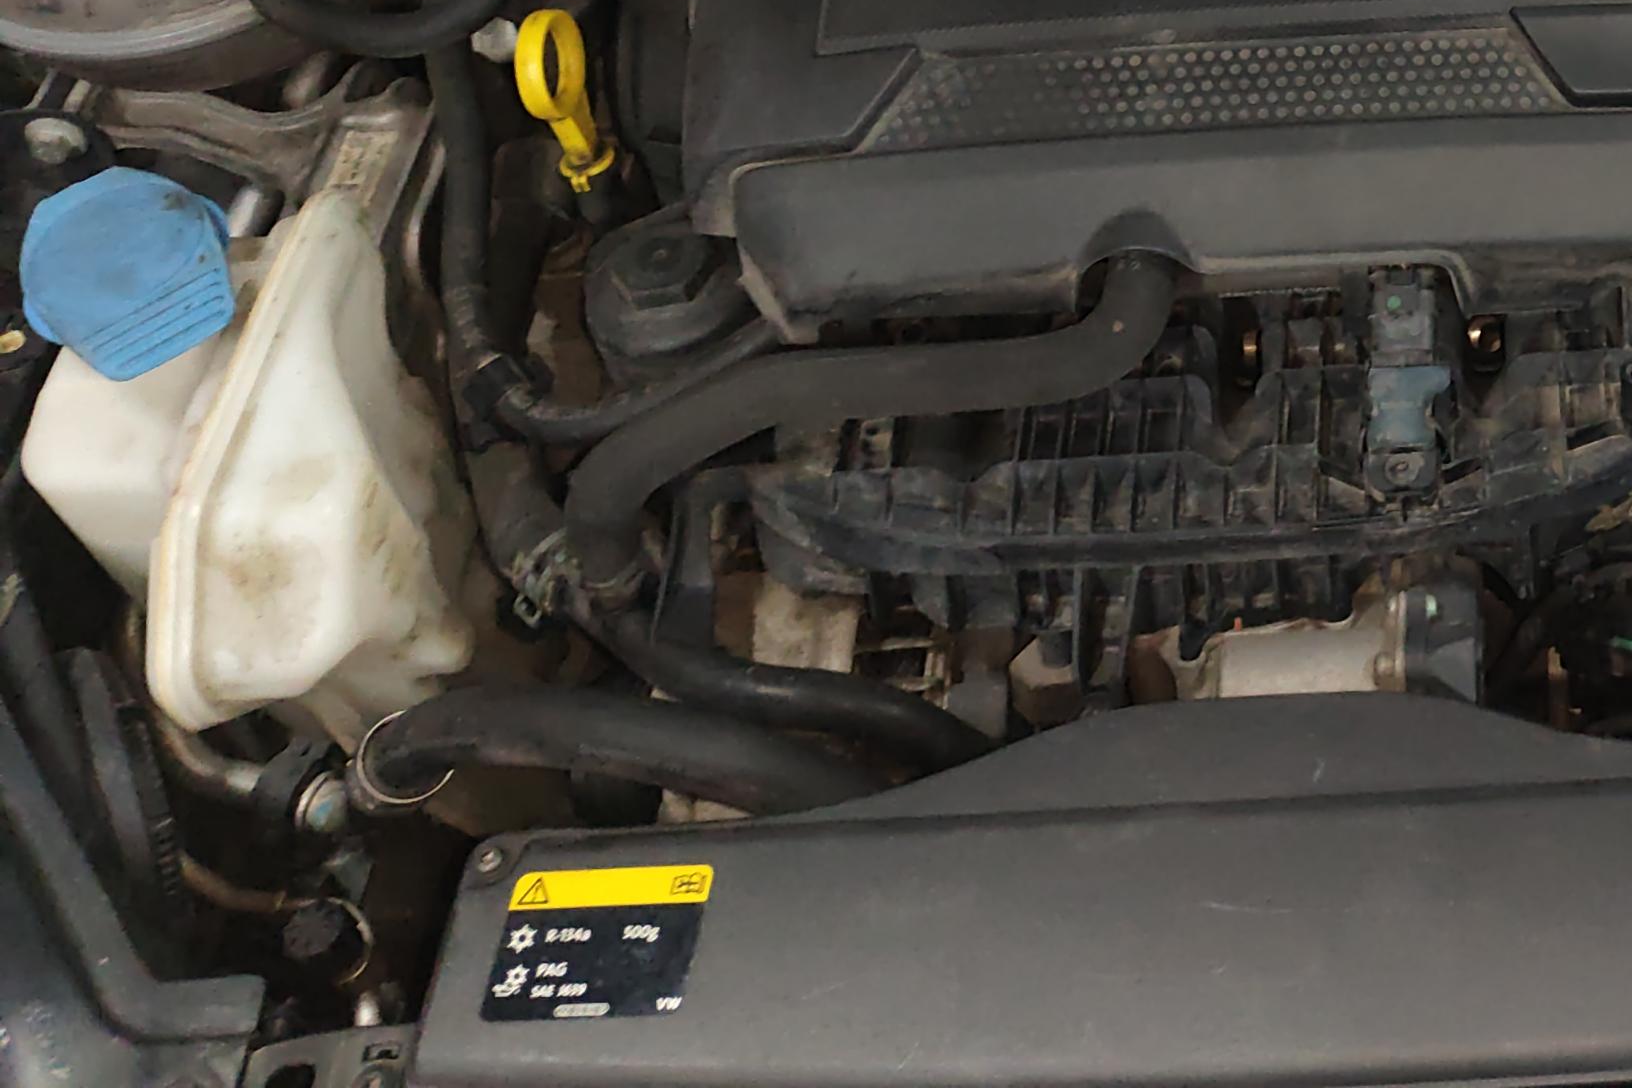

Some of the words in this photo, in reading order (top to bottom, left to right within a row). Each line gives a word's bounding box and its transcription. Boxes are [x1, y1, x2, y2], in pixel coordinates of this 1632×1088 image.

[622, 924, 661, 943] 500g
[535, 961, 568, 978] PAG
[529, 984, 556, 999] SAE
[656, 996, 682, 1011] VW
